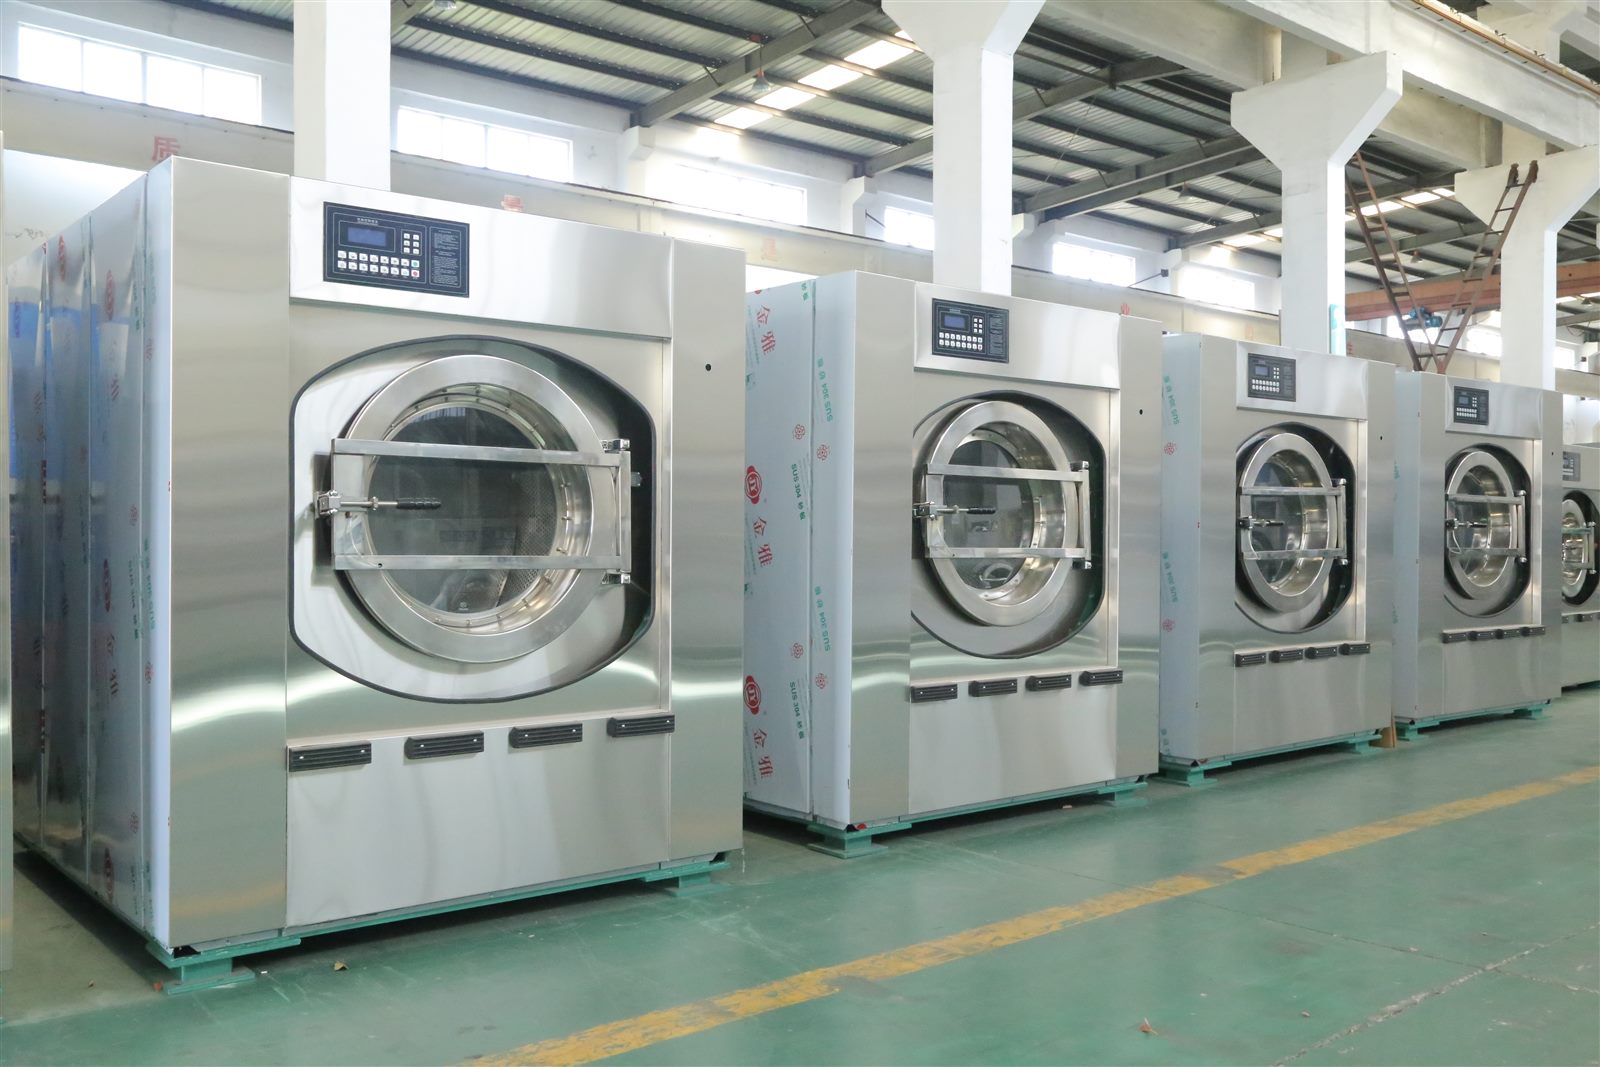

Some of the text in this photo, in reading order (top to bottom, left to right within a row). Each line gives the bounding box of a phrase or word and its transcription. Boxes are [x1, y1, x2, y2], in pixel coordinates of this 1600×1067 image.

[791, 463, 800, 482] SUS
[822, 630, 831, 652] SUS
[790, 681, 801, 717] SUS 304
